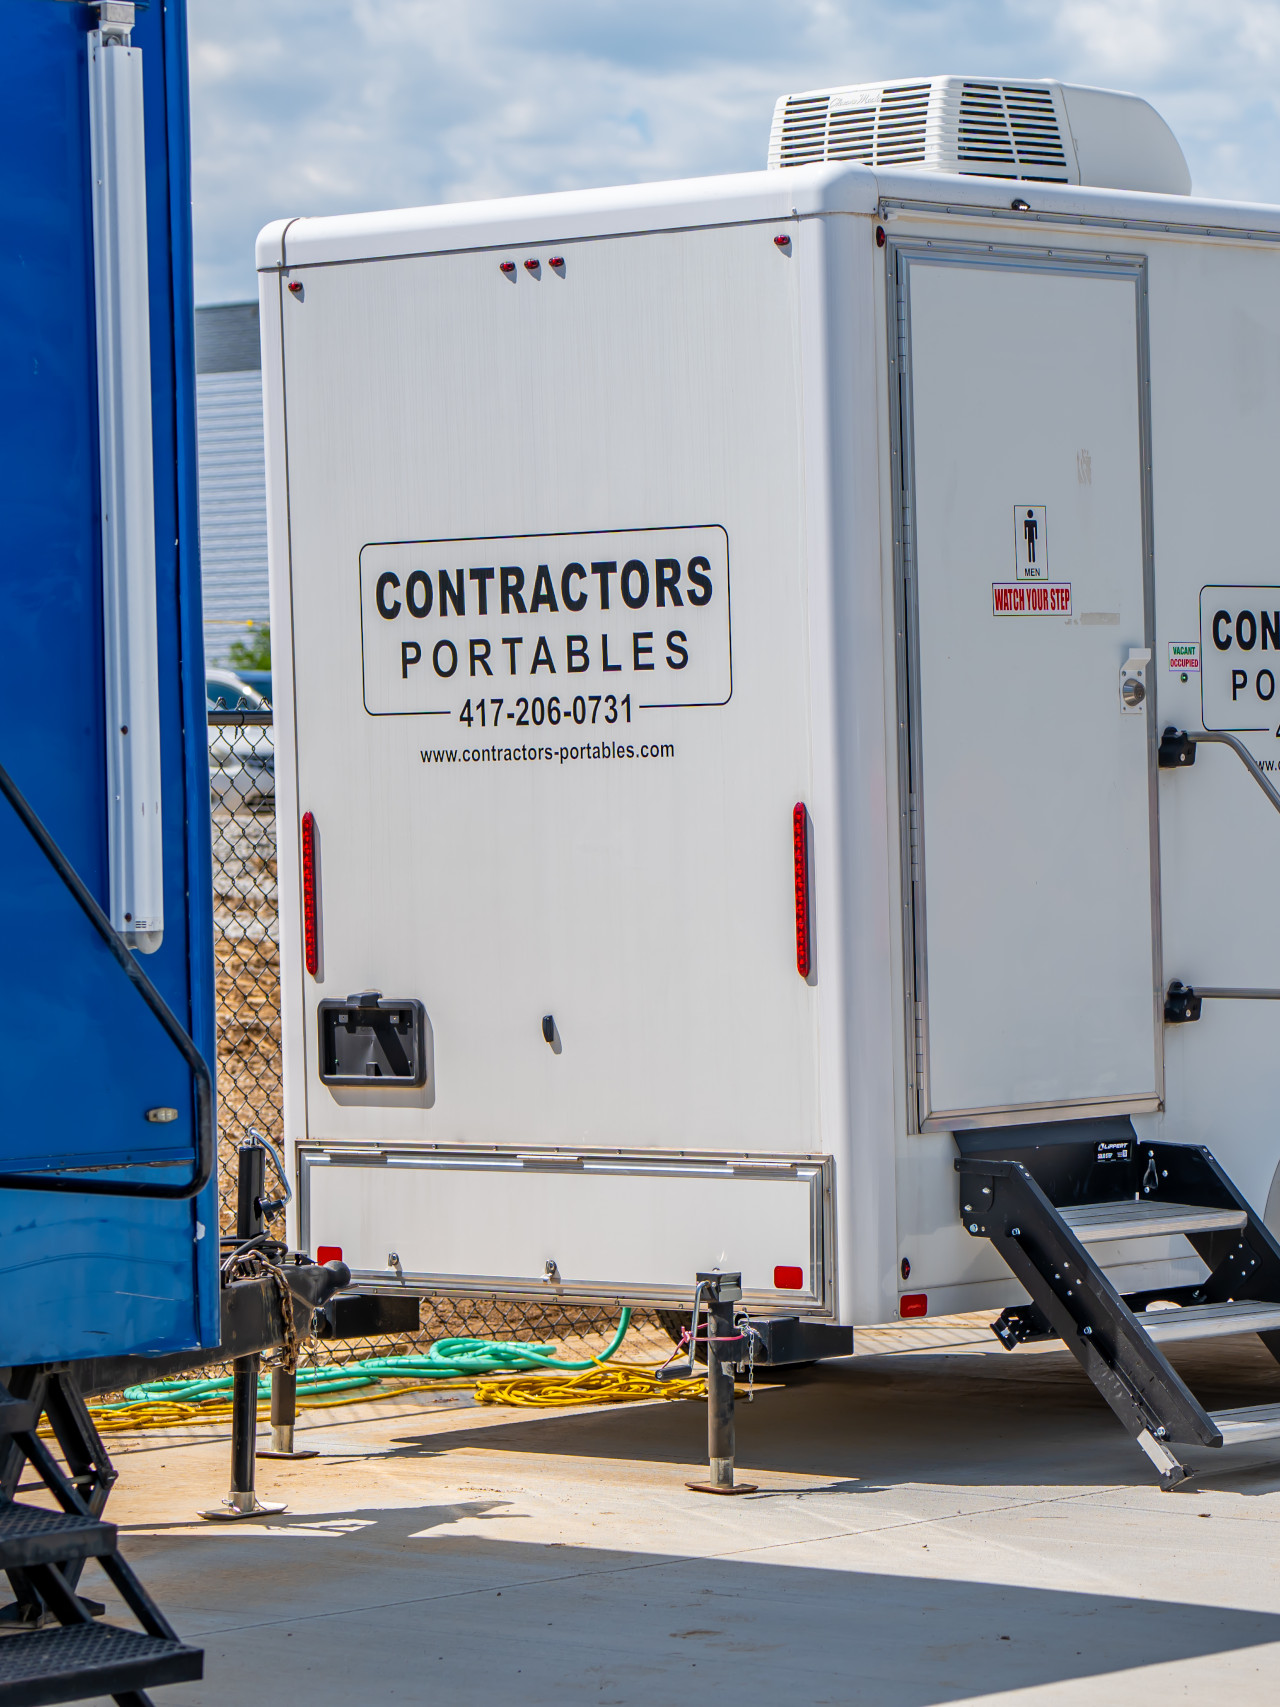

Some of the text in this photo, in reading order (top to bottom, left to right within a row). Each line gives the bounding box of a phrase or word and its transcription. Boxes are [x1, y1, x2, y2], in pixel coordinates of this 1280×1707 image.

[1024, 567, 1041, 577] MEN
[376, 555, 713, 620] CONTRACTORS
[994, 588, 1070, 611] WATCH YOUR STEP
[401, 630, 689, 679] PORTABLES
[1172, 646, 1196, 655] VACANT
[1170, 658, 1199, 667] OCCUPIED
[459, 693, 632, 728] 417-206-0731
[420, 741, 675, 765] www.contractors-portables.com
